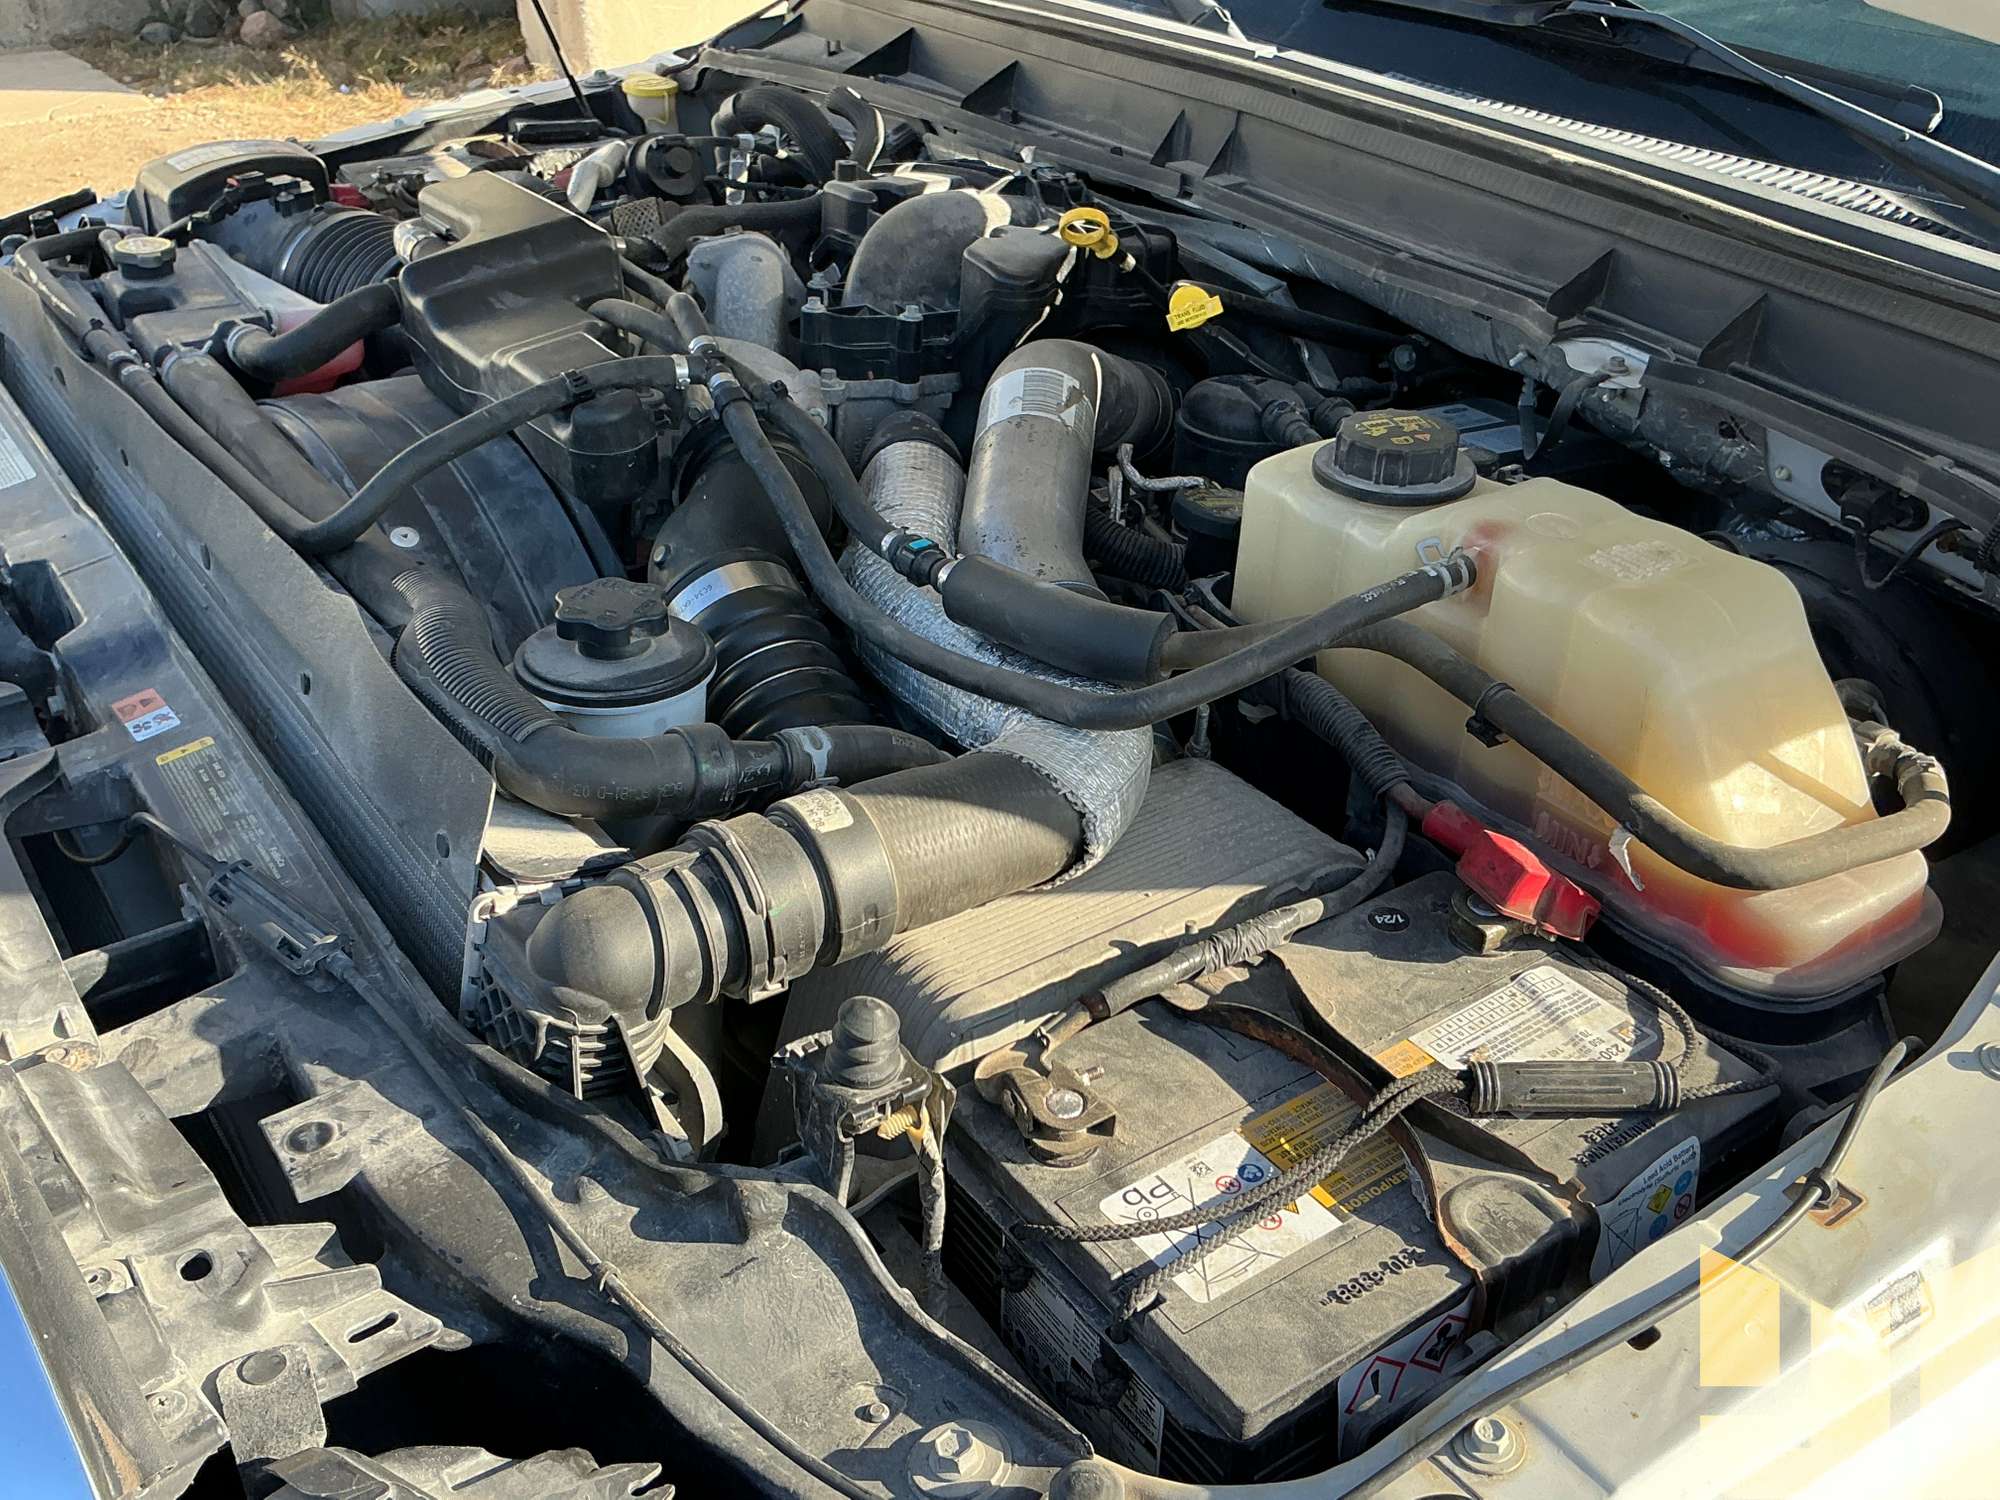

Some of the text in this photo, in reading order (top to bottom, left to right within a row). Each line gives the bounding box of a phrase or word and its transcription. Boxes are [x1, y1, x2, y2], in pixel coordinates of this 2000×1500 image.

[1374, 913, 1406, 925] 1/24
[1659, 1158, 1673, 1172] Acid
[1121, 1174, 1173, 1208] Pb
